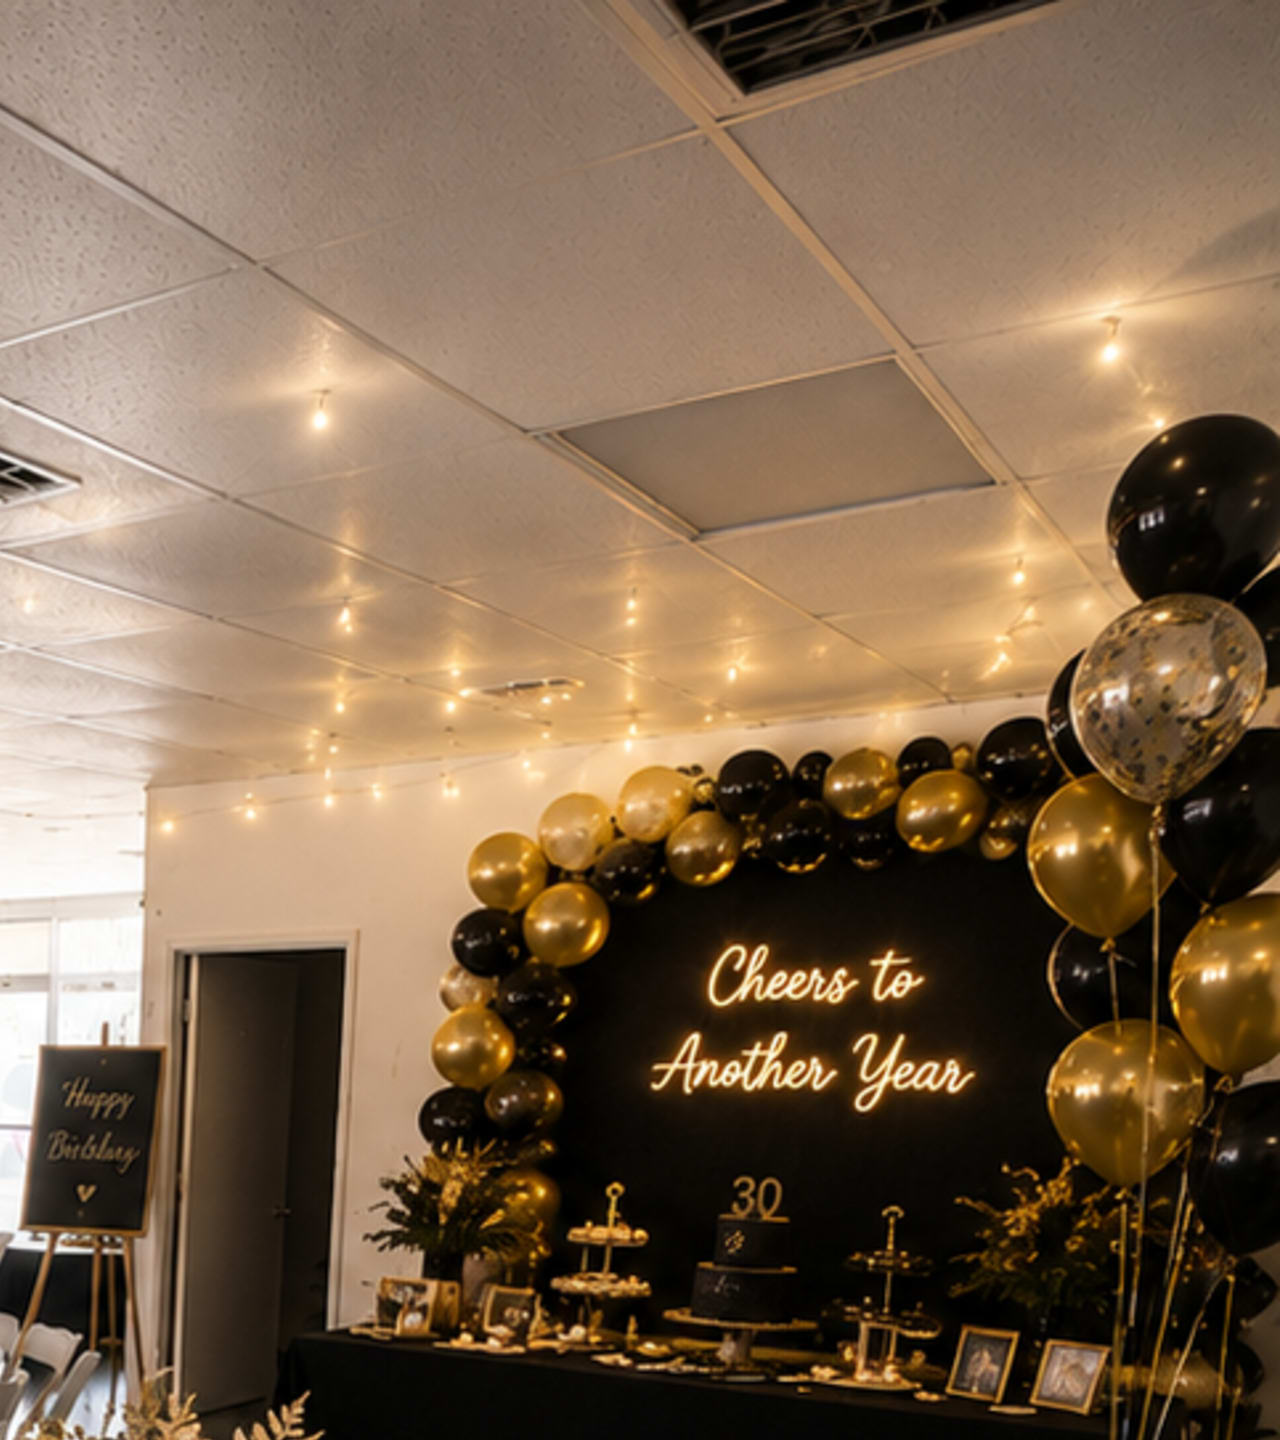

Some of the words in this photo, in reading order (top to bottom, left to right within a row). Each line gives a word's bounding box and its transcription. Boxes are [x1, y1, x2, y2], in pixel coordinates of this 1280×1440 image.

[708, 944, 860, 1007] Cheers
[869, 949, 926, 1002] to
[650, 1031, 839, 1095] Another
[852, 1033, 976, 1113] Year
[731, 1176, 783, 1217] 30
